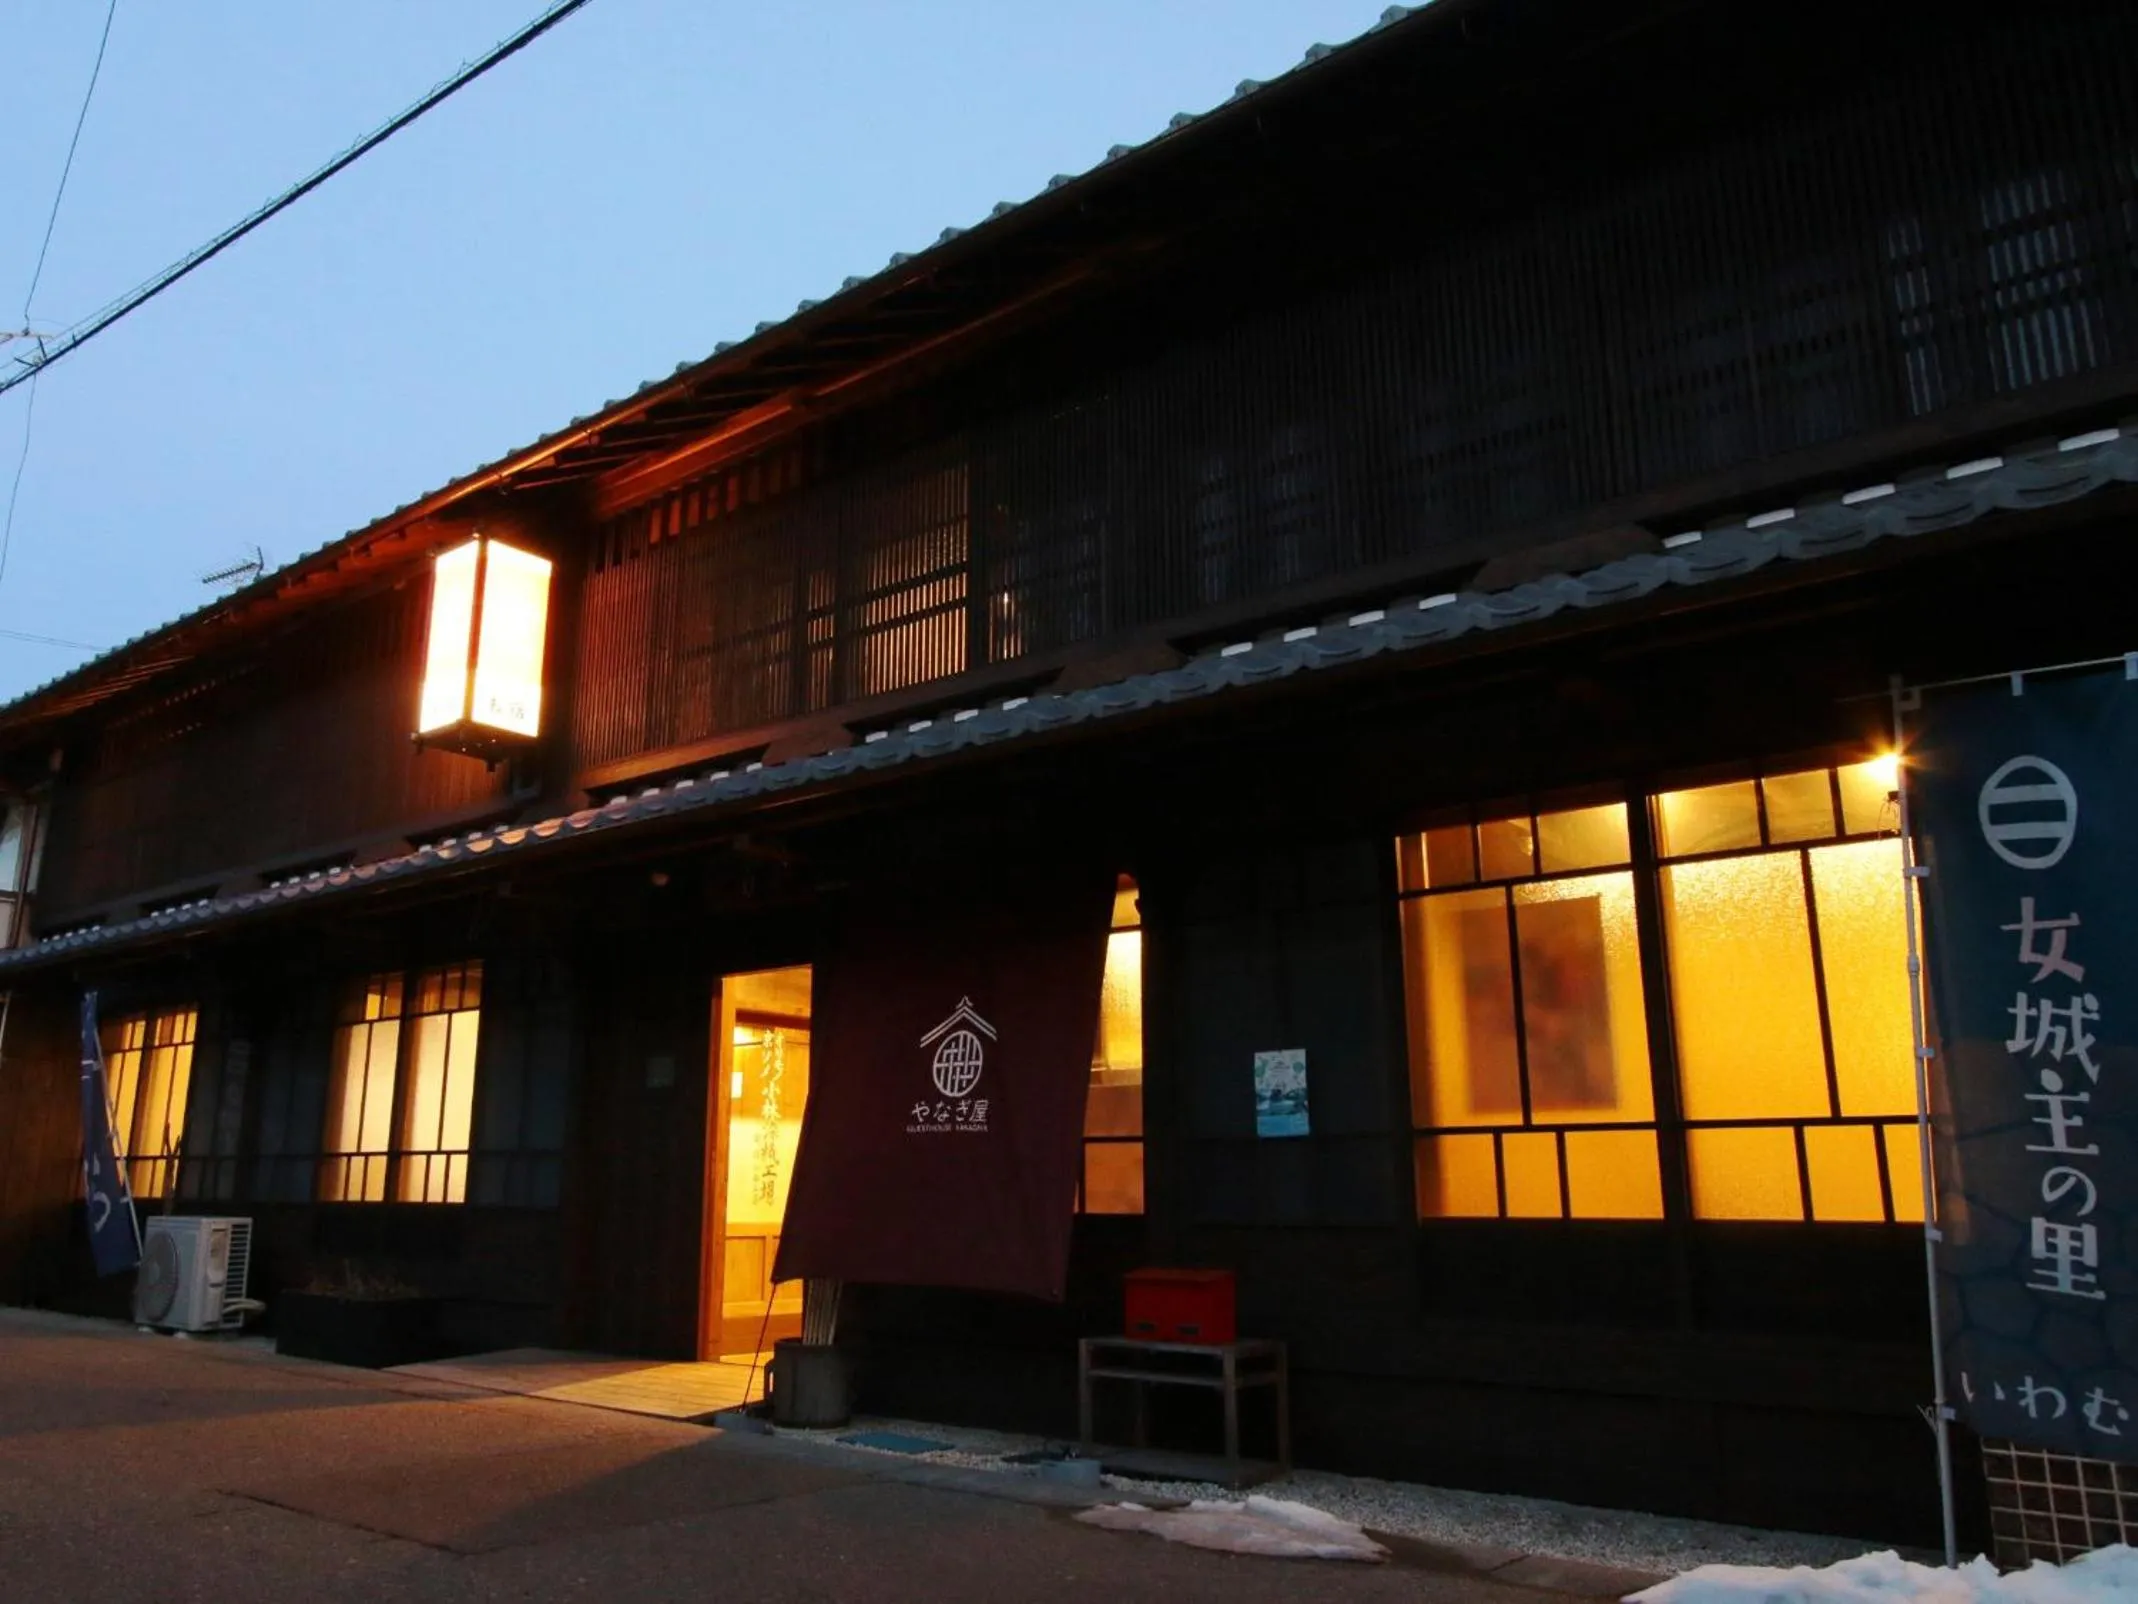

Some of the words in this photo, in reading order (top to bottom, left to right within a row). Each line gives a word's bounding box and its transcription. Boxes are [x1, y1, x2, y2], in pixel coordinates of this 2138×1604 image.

[911, 1099, 990, 1123] やなぎ屋
[2000, 895, 2107, 1302] 女城主の里
[1960, 1370, 2131, 1436] いわむ
